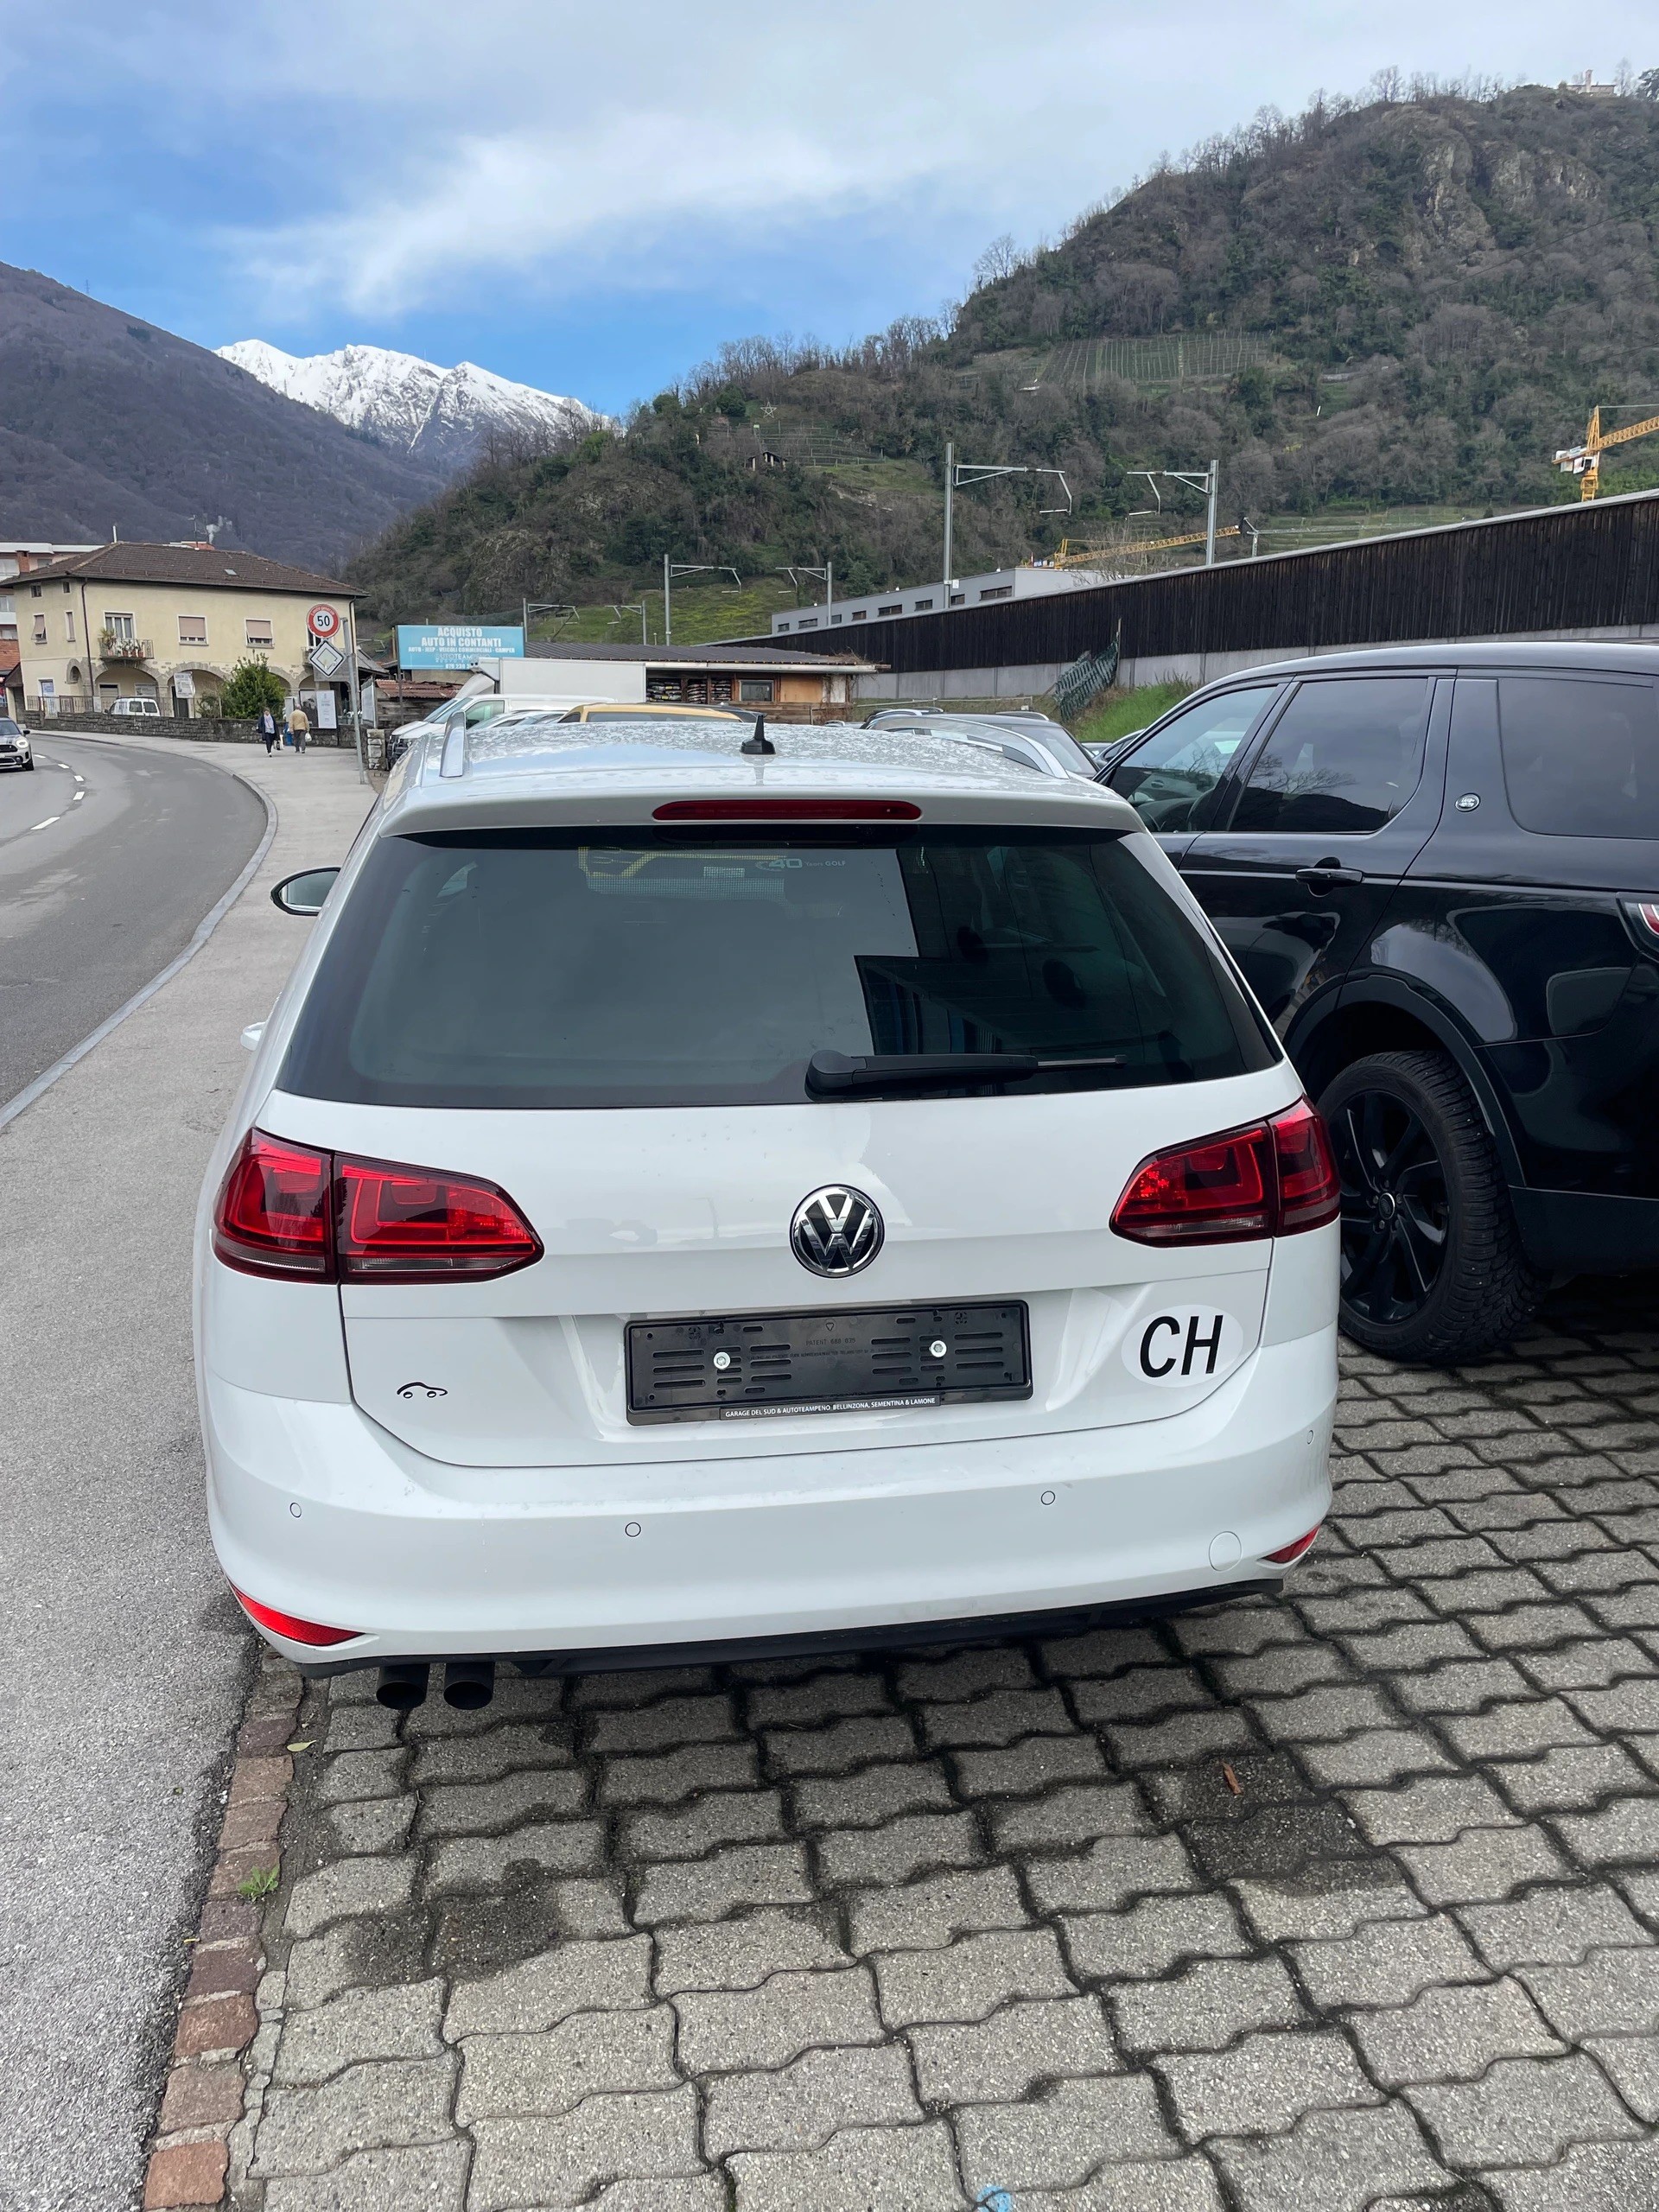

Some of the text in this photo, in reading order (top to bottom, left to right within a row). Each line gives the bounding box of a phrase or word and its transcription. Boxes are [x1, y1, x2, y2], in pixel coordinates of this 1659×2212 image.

[317, 615, 330, 626] 50
[438, 627, 483, 638] ACQUISTO
[421, 637, 501, 647] AUTO IN CONTANTI
[769, 858, 803, 869] 40
[1140, 1315, 1224, 1378] CH
[725, 1409, 750, 1417] GARAGE
[782, 1405, 830, 1413] AUTOTEAMPENO
[833, 1402, 871, 1410] BELLINZONA,
[871, 1399, 904, 1408] SEMENTINA
